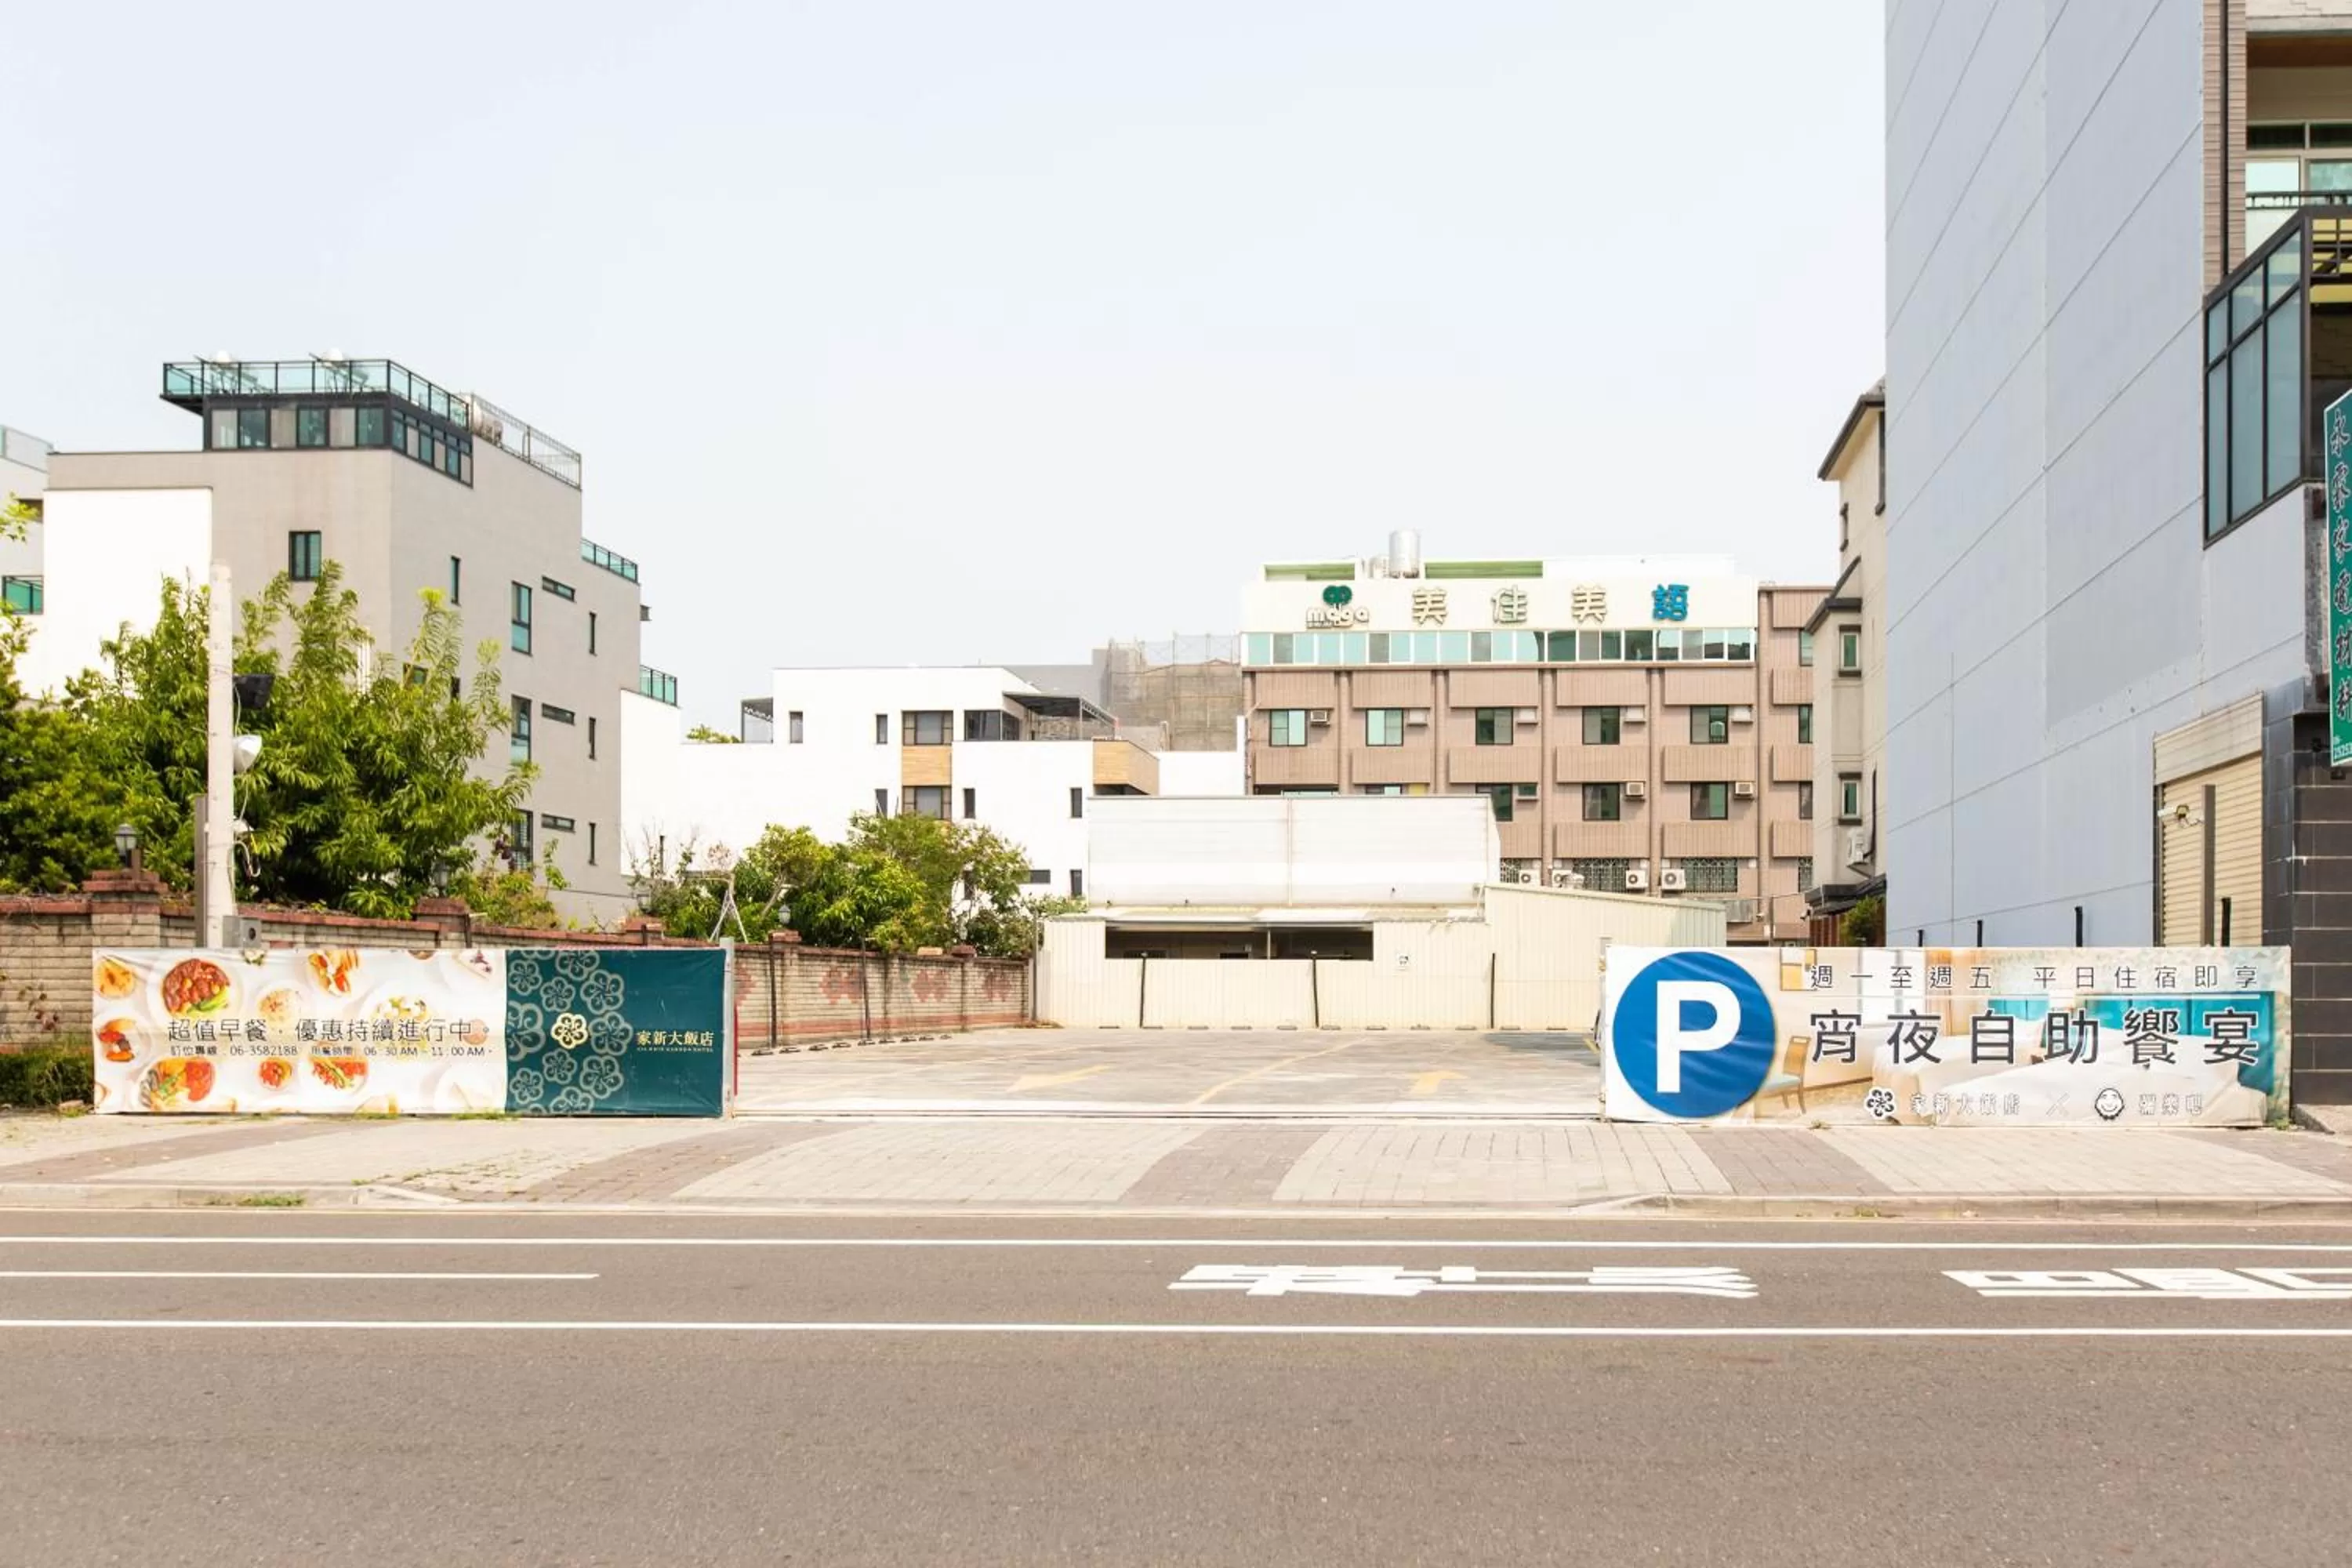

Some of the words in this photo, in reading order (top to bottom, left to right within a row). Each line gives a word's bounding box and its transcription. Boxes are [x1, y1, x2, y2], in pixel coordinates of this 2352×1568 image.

[1410, 583, 1690, 625] 美佳美語
[1810, 965, 1991, 989] 週一至週五
[2033, 964, 2258, 989] 平日住宿即享
[1656, 979, 1741, 1094] P
[1809, 1008, 2258, 1066] 宵夜自助饗宴
